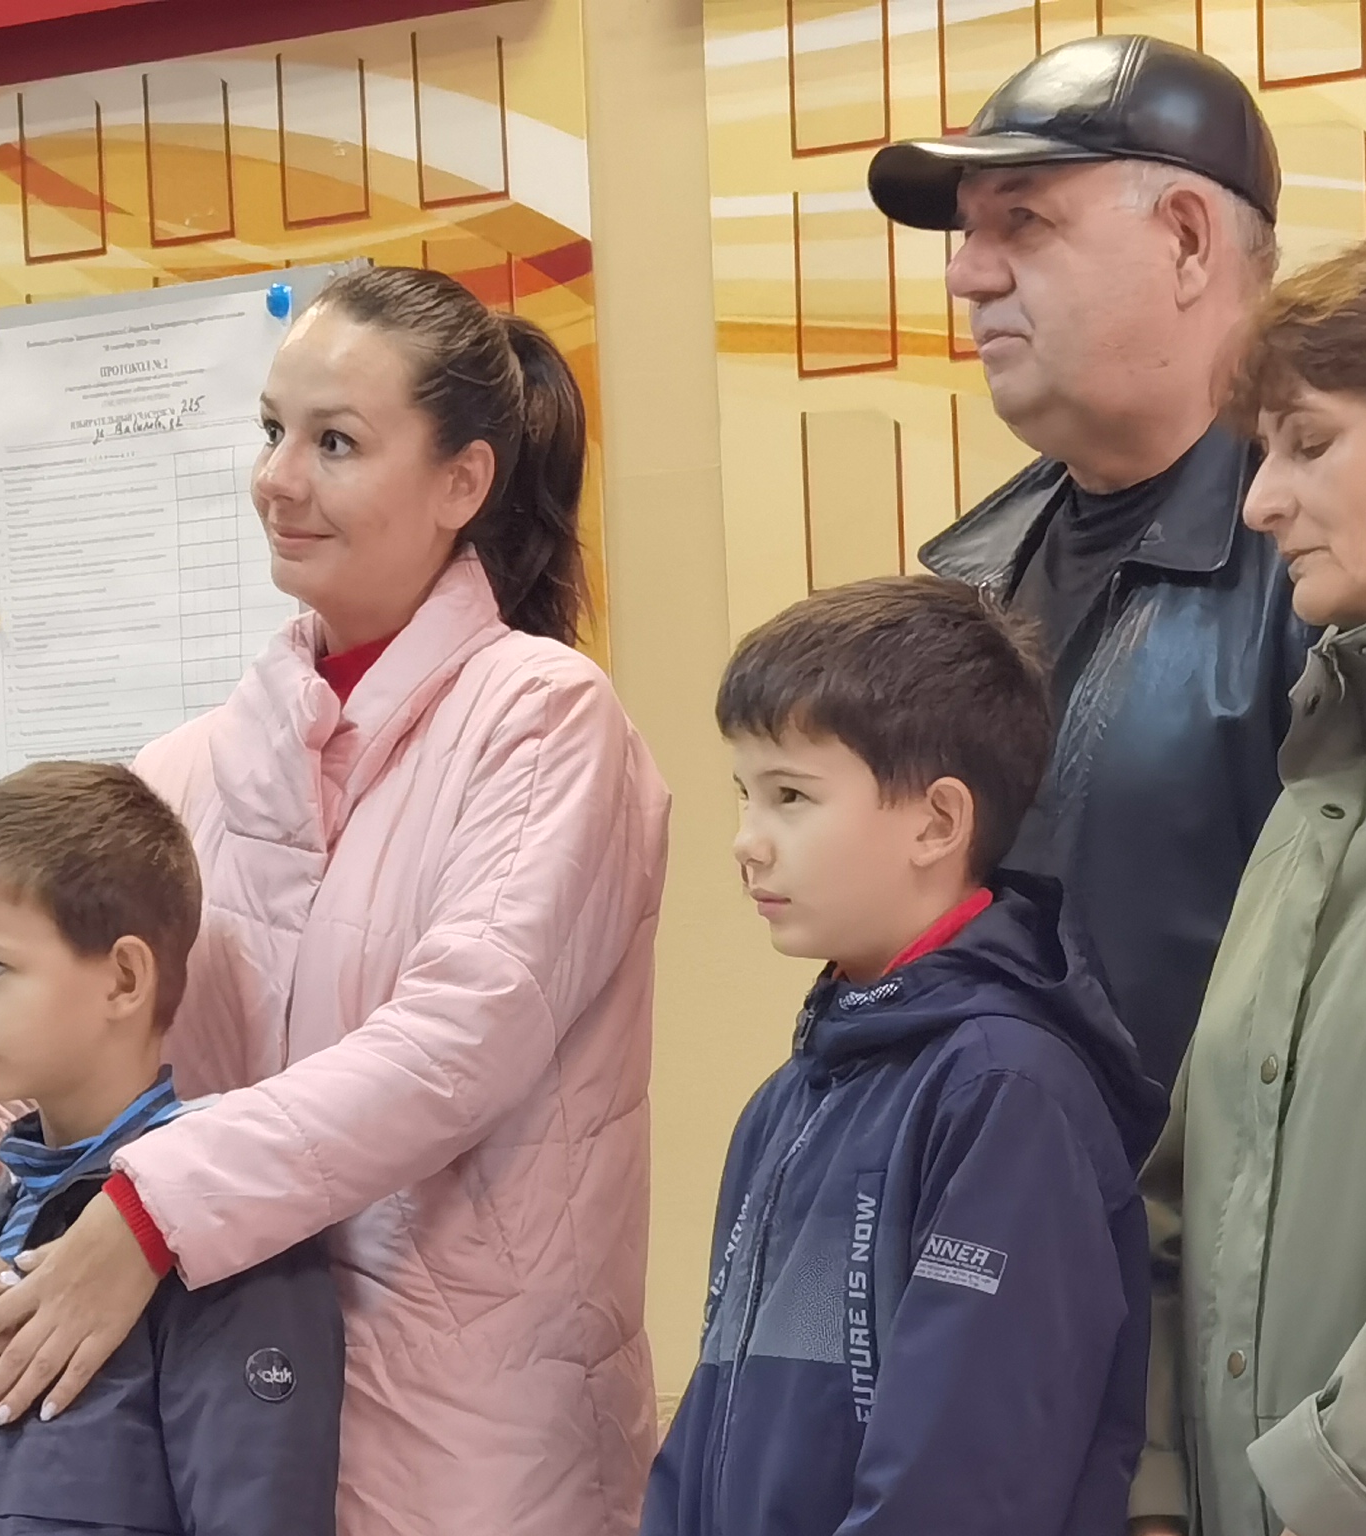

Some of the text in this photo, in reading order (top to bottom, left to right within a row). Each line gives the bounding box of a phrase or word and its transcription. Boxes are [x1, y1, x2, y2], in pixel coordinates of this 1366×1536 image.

[848, 1192, 877, 1424] FUTURE IS NOW
